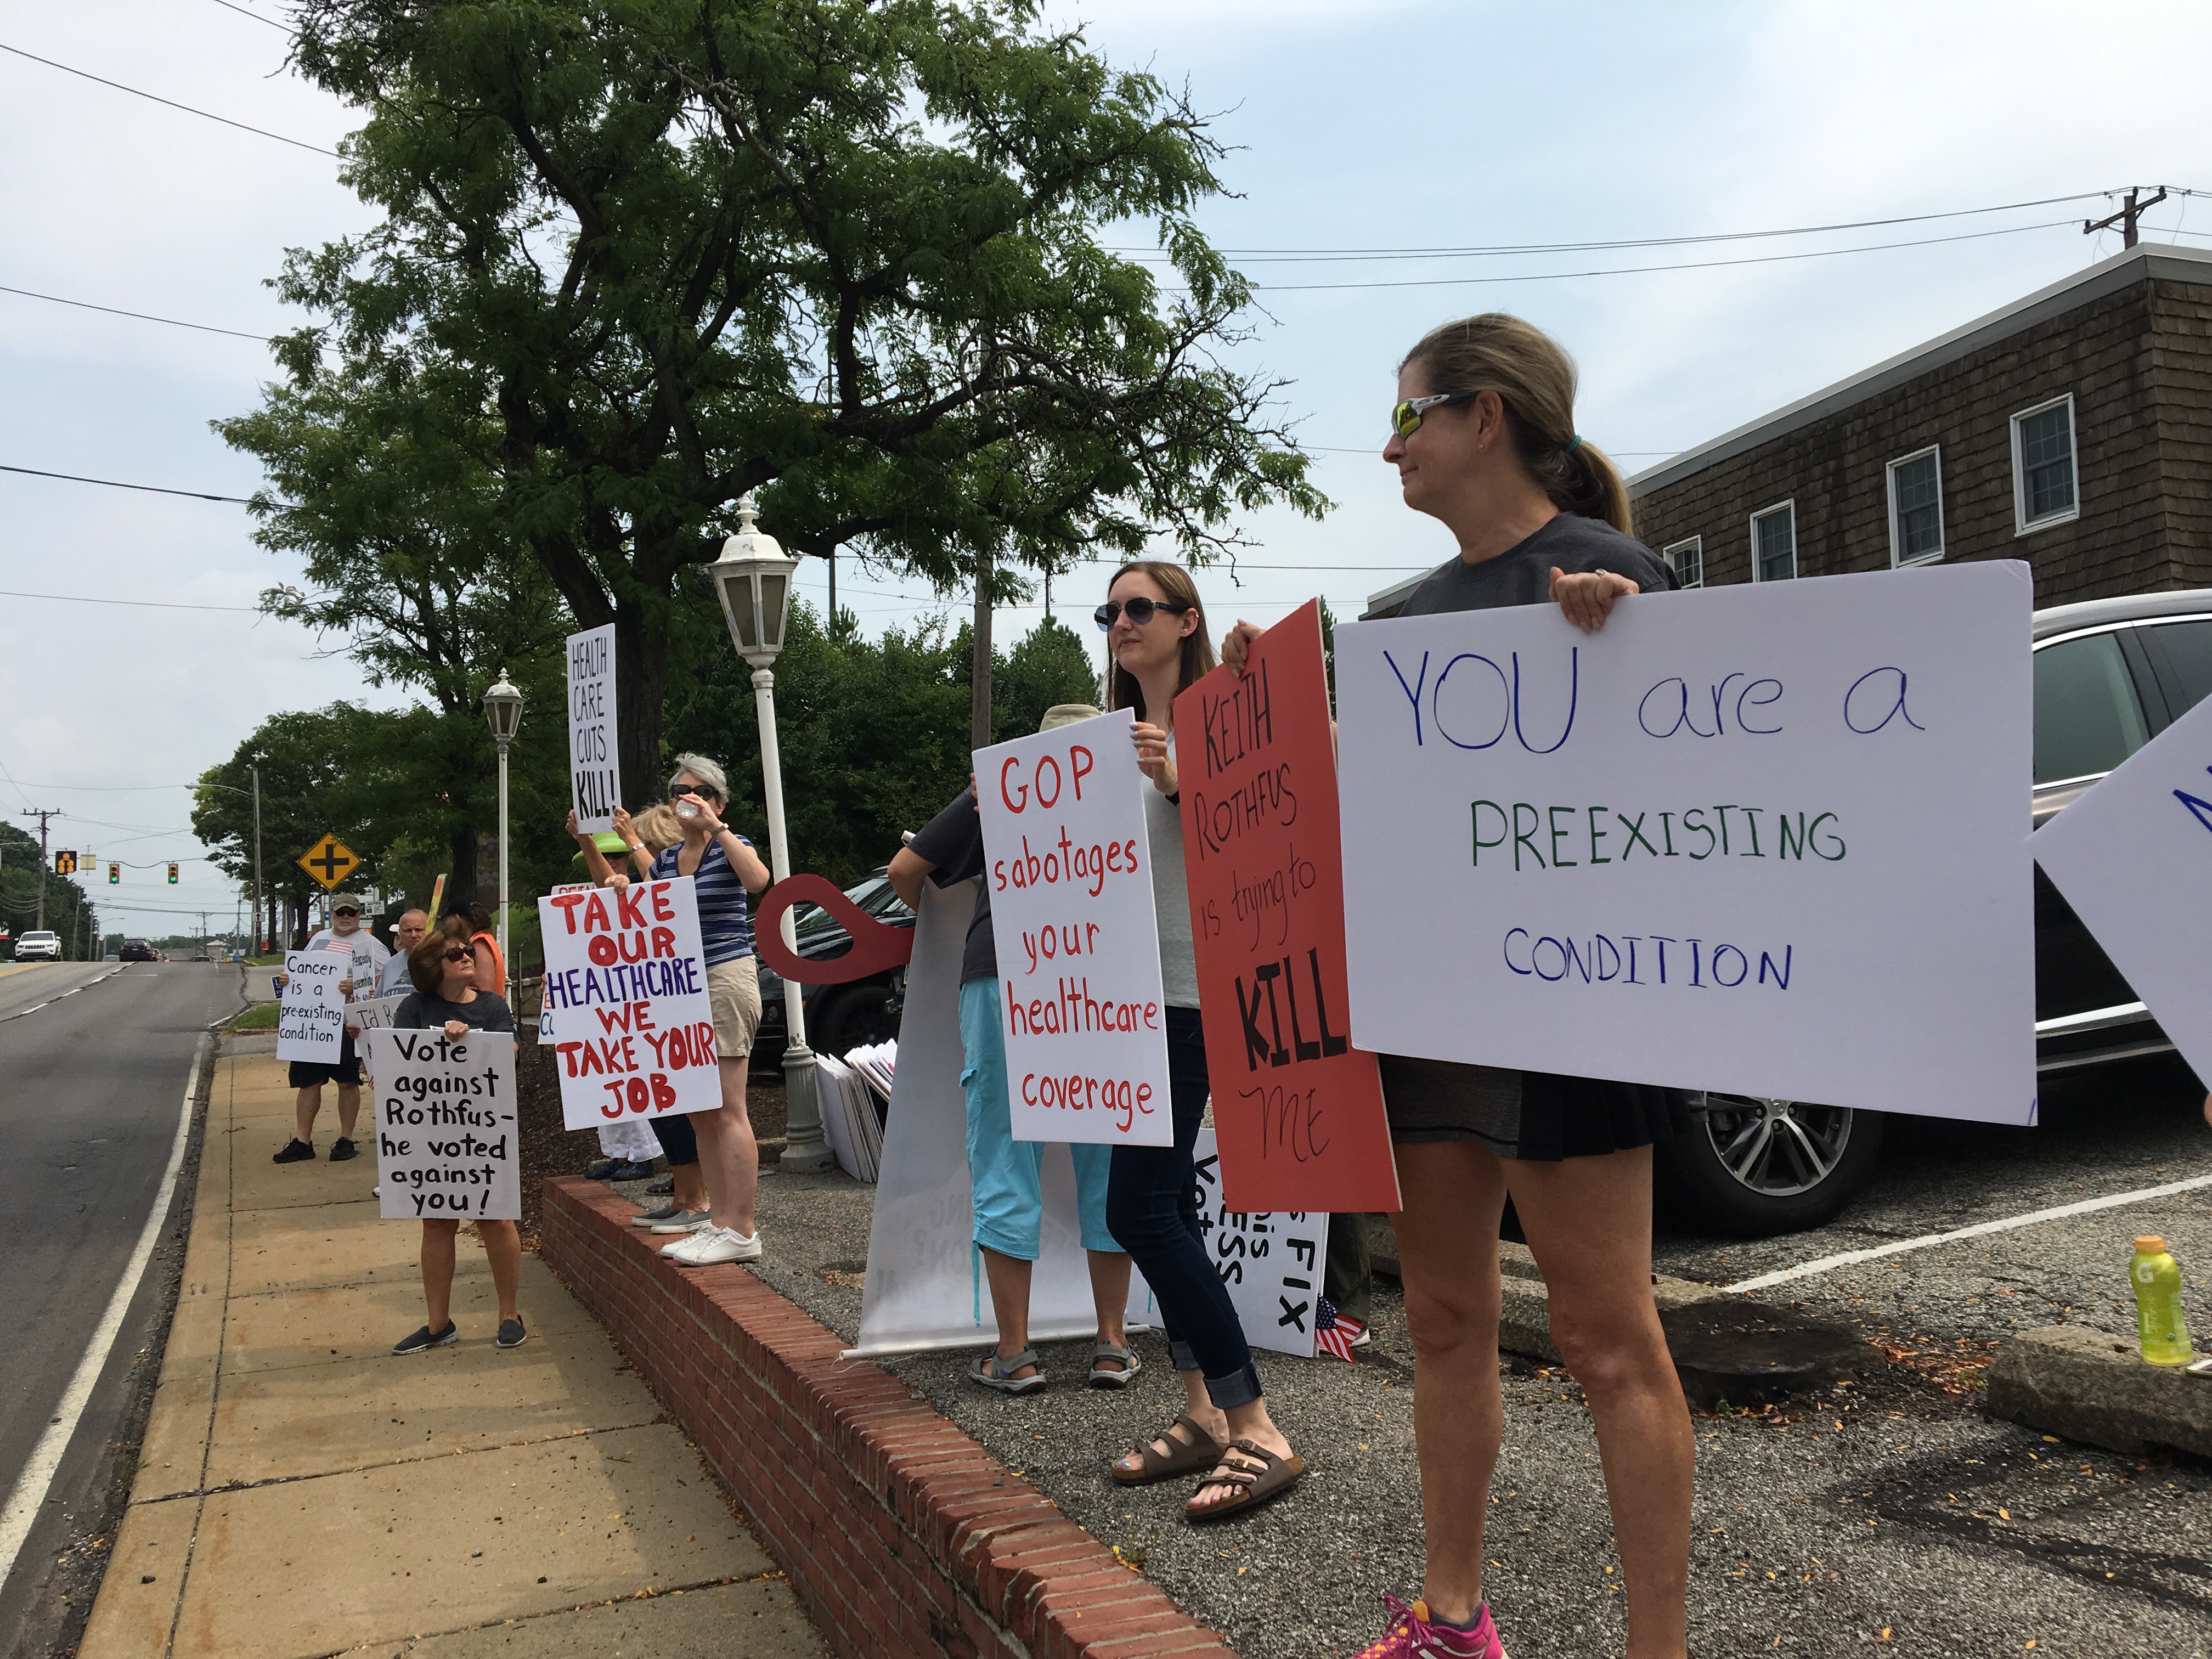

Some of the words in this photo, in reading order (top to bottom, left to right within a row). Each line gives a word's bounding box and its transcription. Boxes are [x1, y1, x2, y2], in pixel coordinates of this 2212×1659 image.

[572, 637, 607, 681] HEALTH
[574, 682, 605, 721] CARE
[1202, 657, 1273, 780] KEITH
[1383, 646, 1578, 754] YOU
[1638, 673, 1783, 738] are
[1844, 667, 1926, 734] a
[577, 724, 606, 764] CUTS
[576, 769, 615, 821] KILL!
[1001, 745, 1093, 814] GOP
[1194, 763, 1297, 861] ROTHFUS
[1471, 800, 1847, 872] PREEXISTING
[994, 825, 1138, 898] sabotages
[550, 882, 675, 935] TAKE
[1231, 870, 1288, 952] trying
[1289, 842, 1316, 899] to
[287, 955, 337, 975] Cancer
[588, 926, 676, 967] OUR
[1023, 922, 1100, 974] your
[1504, 927, 1792, 990] CONDITION
[291, 979, 302, 995] is
[313, 984, 323, 996] a
[548, 957, 702, 1009] HEALTHCARE
[1007, 977, 1158, 1037] healthcare
[1234, 946, 1348, 1072] KILL
[279, 1022, 334, 1042] condition
[281, 1006, 342, 1026] pre-existing
[356, 1008, 380, 1030] I'd
[595, 1001, 656, 1035] WE
[392, 1034, 468, 1063] Vote
[556, 1036, 640, 1078] TAKE
[643, 1022, 718, 1071] YOUR
[394, 1067, 499, 1102] against
[600, 1073, 676, 1119] JOB
[1022, 1073, 1155, 1133] coverage
[381, 1132, 412, 1157] he
[427, 1132, 506, 1161] voted
[391, 1164, 495, 1189] against
[1216, 1194, 1248, 1285] ESS
[1278, 1238, 1316, 1334] FIX
[2136, 1262, 2155, 1284] G
